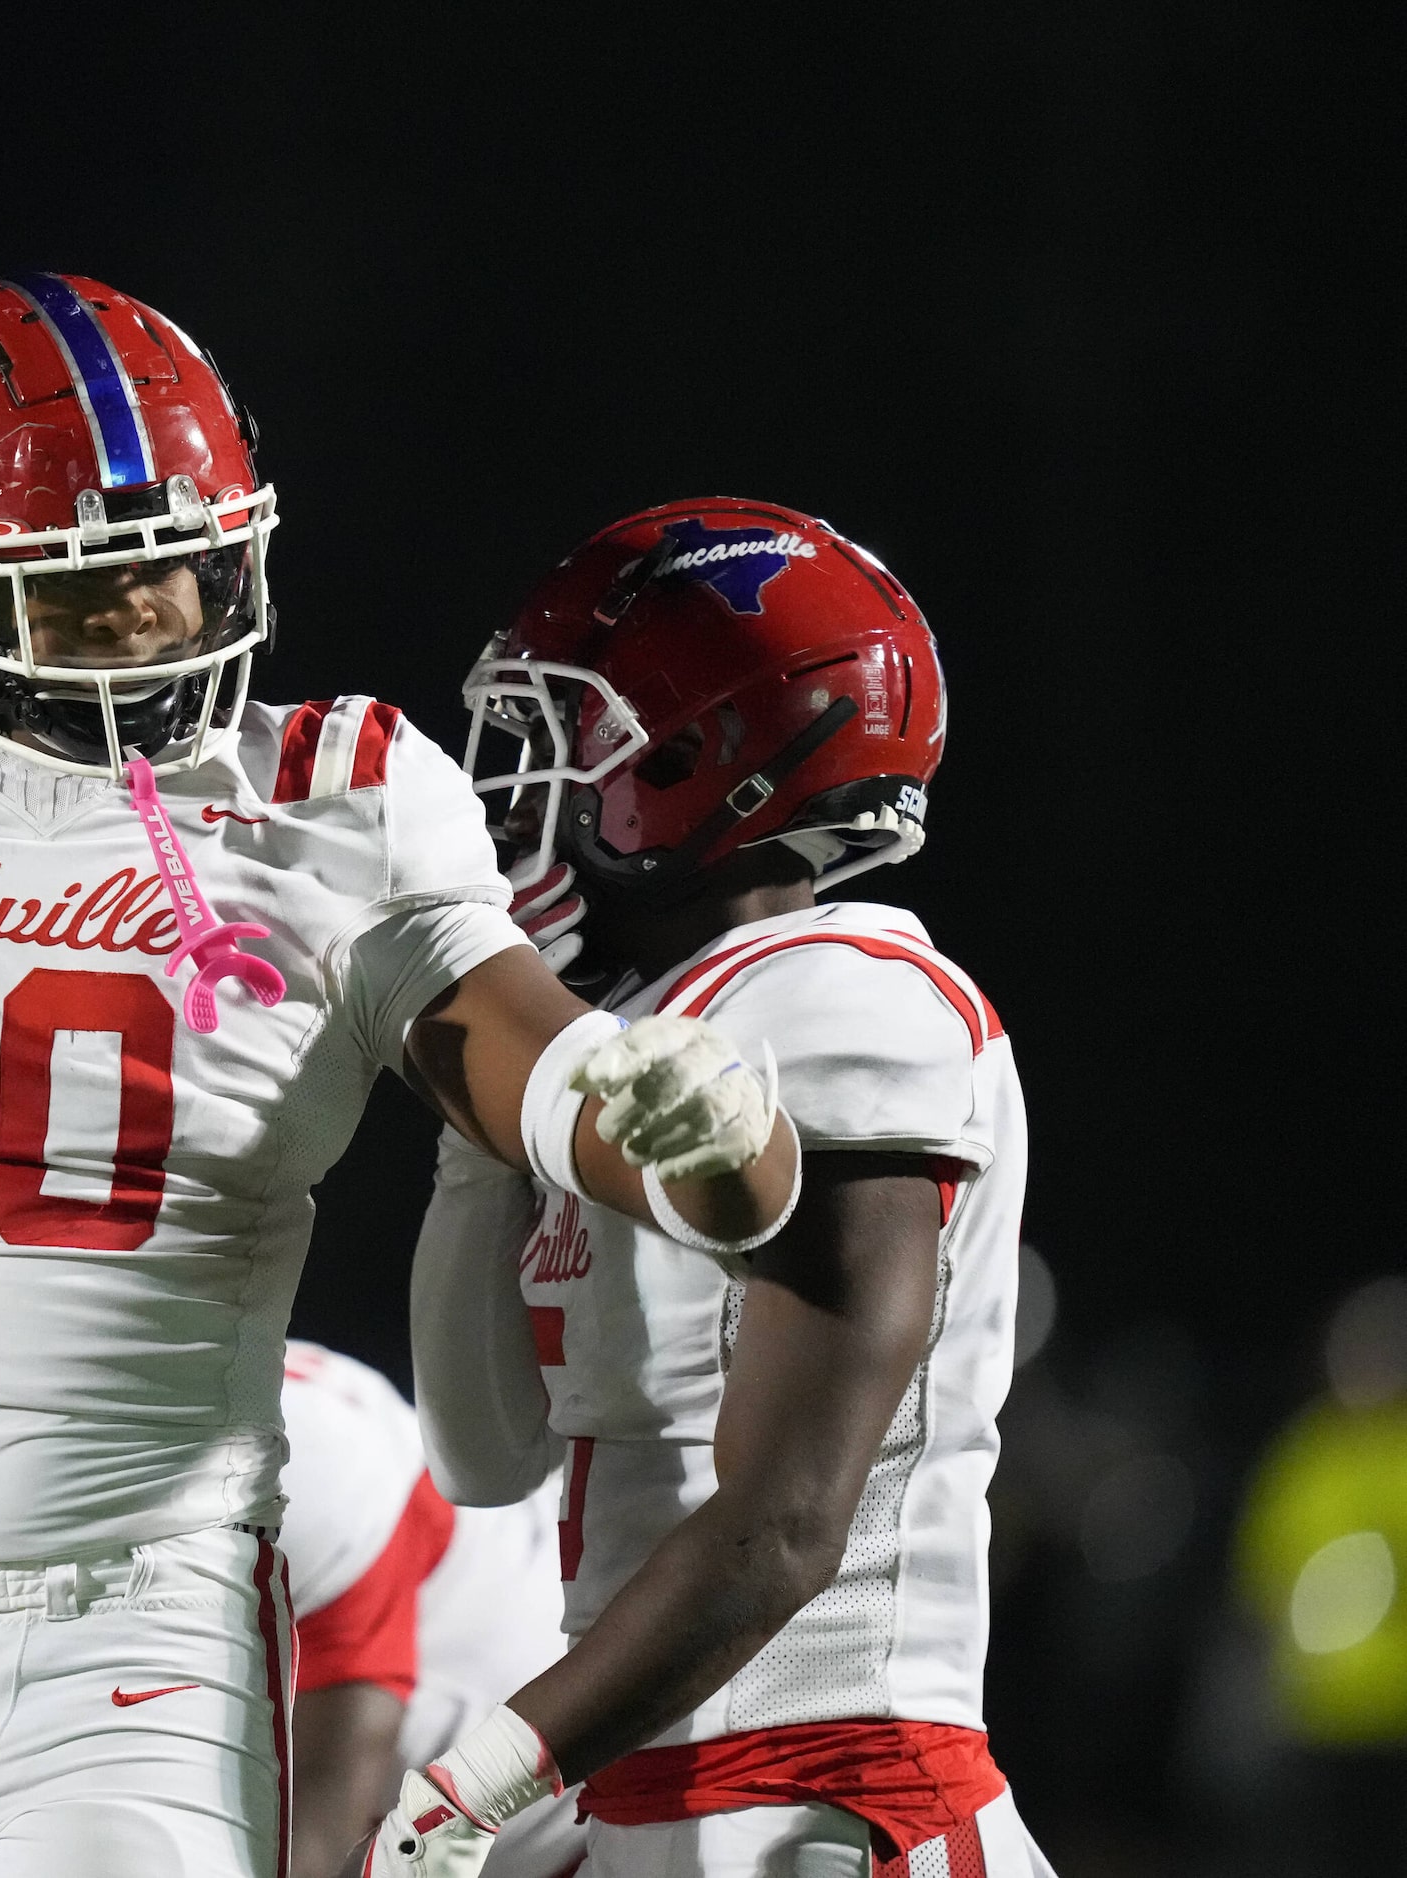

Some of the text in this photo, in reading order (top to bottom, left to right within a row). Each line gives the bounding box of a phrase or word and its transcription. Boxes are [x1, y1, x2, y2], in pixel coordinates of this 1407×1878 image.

[864, 723, 889, 735] LARGE
[147, 804, 204, 927] WE BALL
